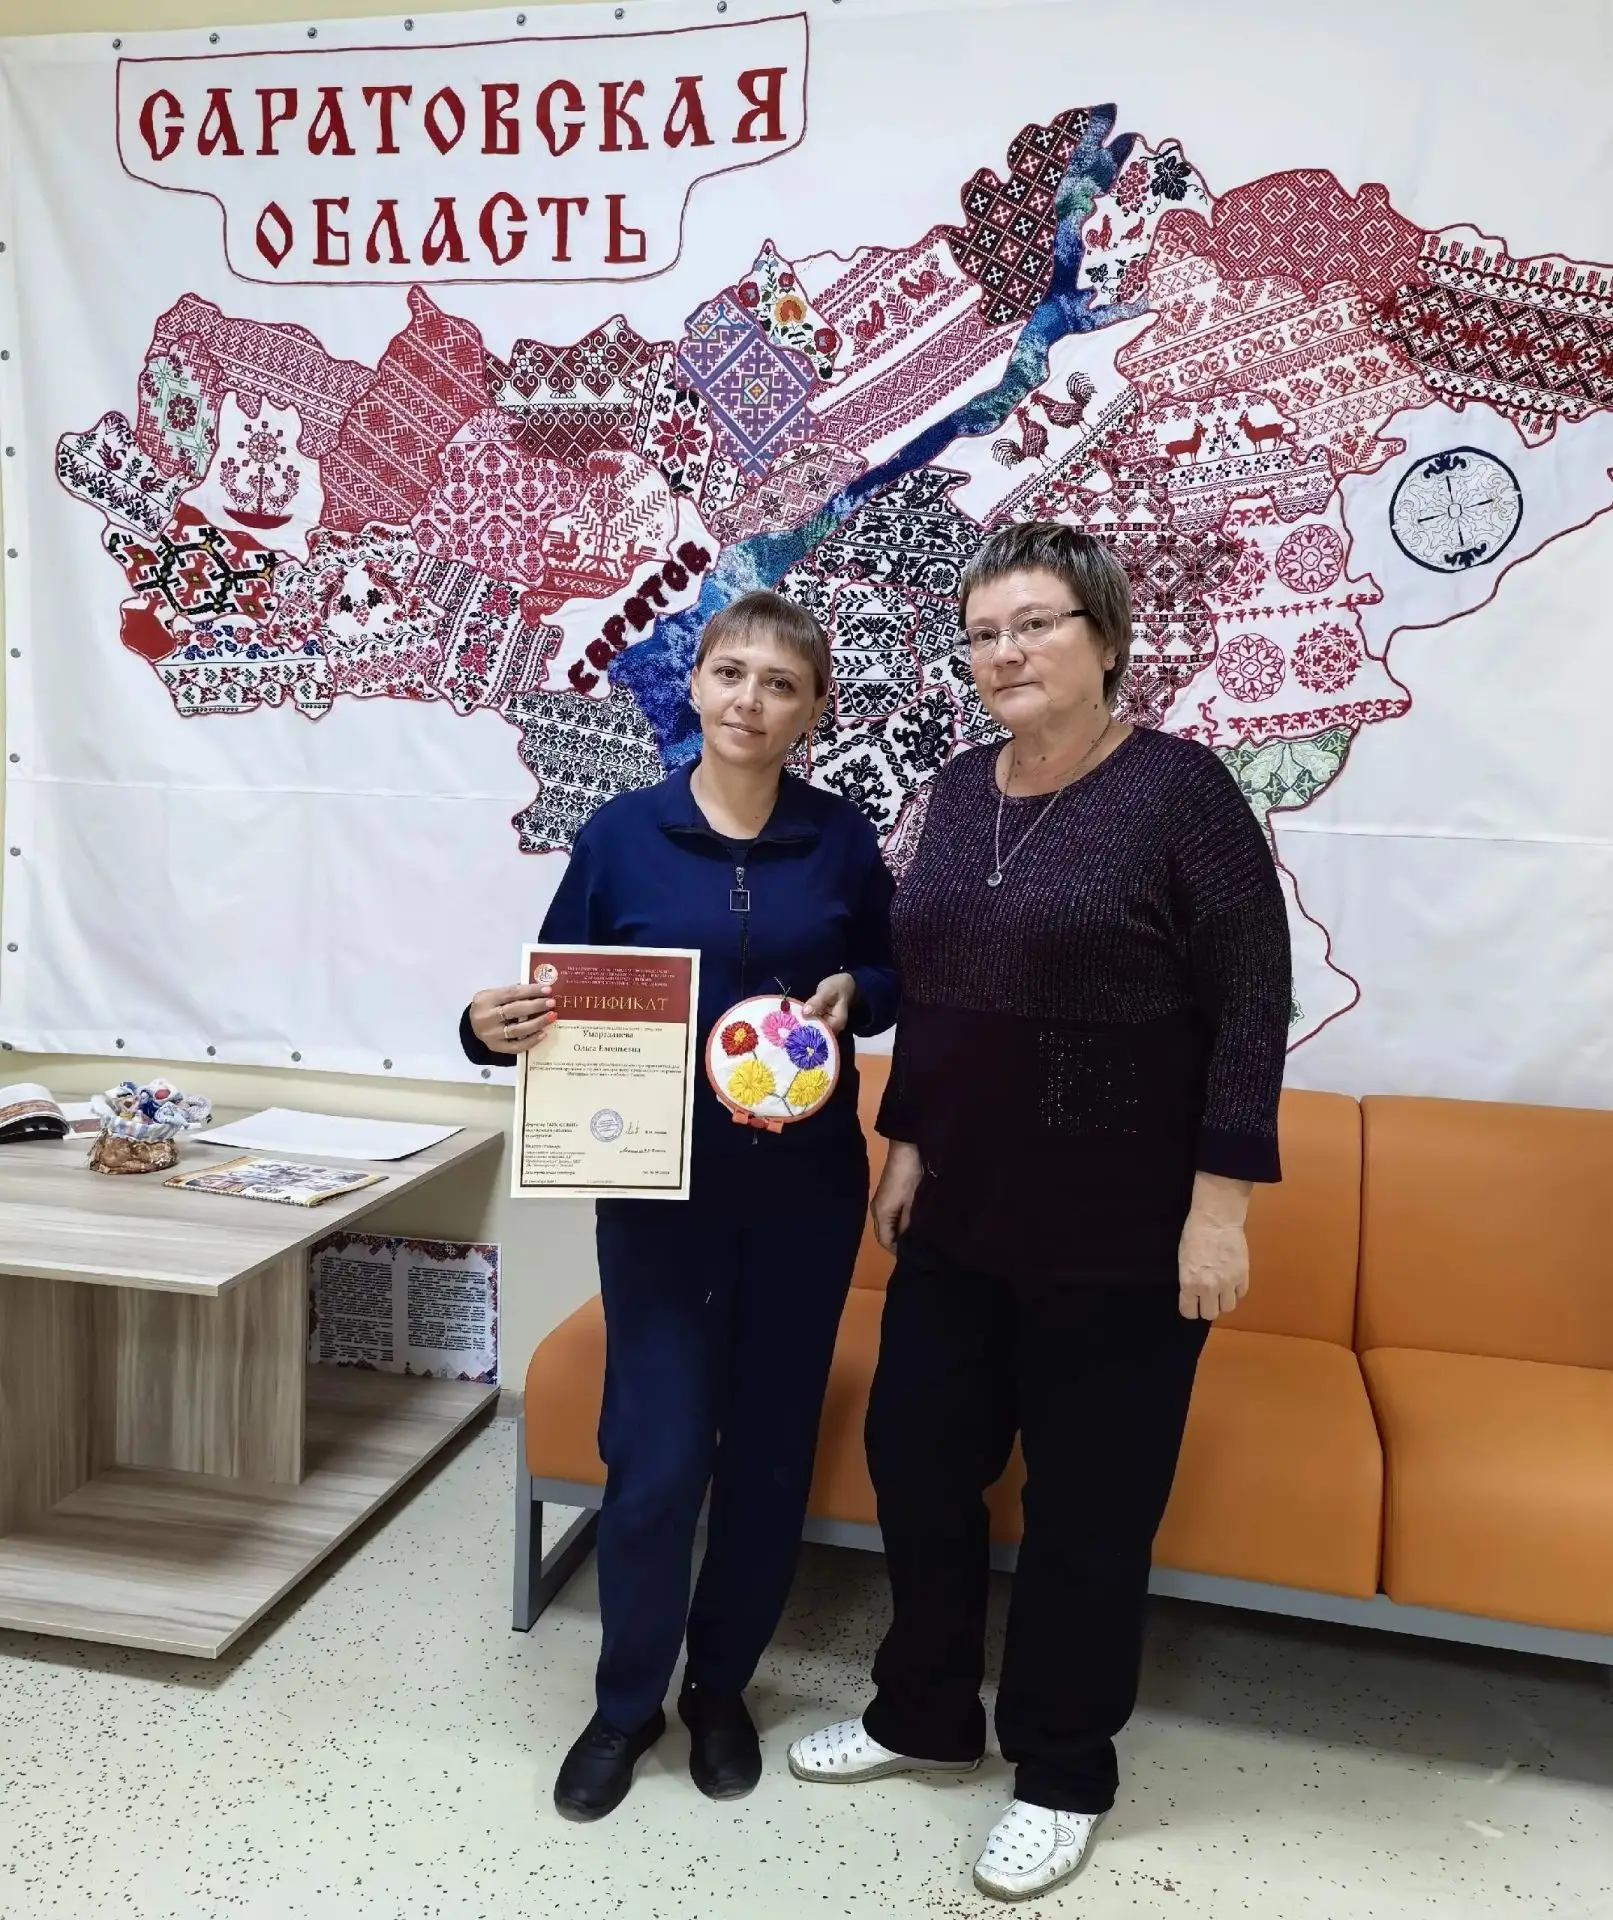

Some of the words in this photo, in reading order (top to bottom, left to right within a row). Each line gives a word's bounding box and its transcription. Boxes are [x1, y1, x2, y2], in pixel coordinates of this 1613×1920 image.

[139, 66, 788, 161] САРАТОВСКАЯ
[255, 191, 648, 269] ОБЛАСТЬ
[567, 541, 711, 696] САРАТОВ
[552, 994, 669, 1011] СЕРТИФИКАТ
